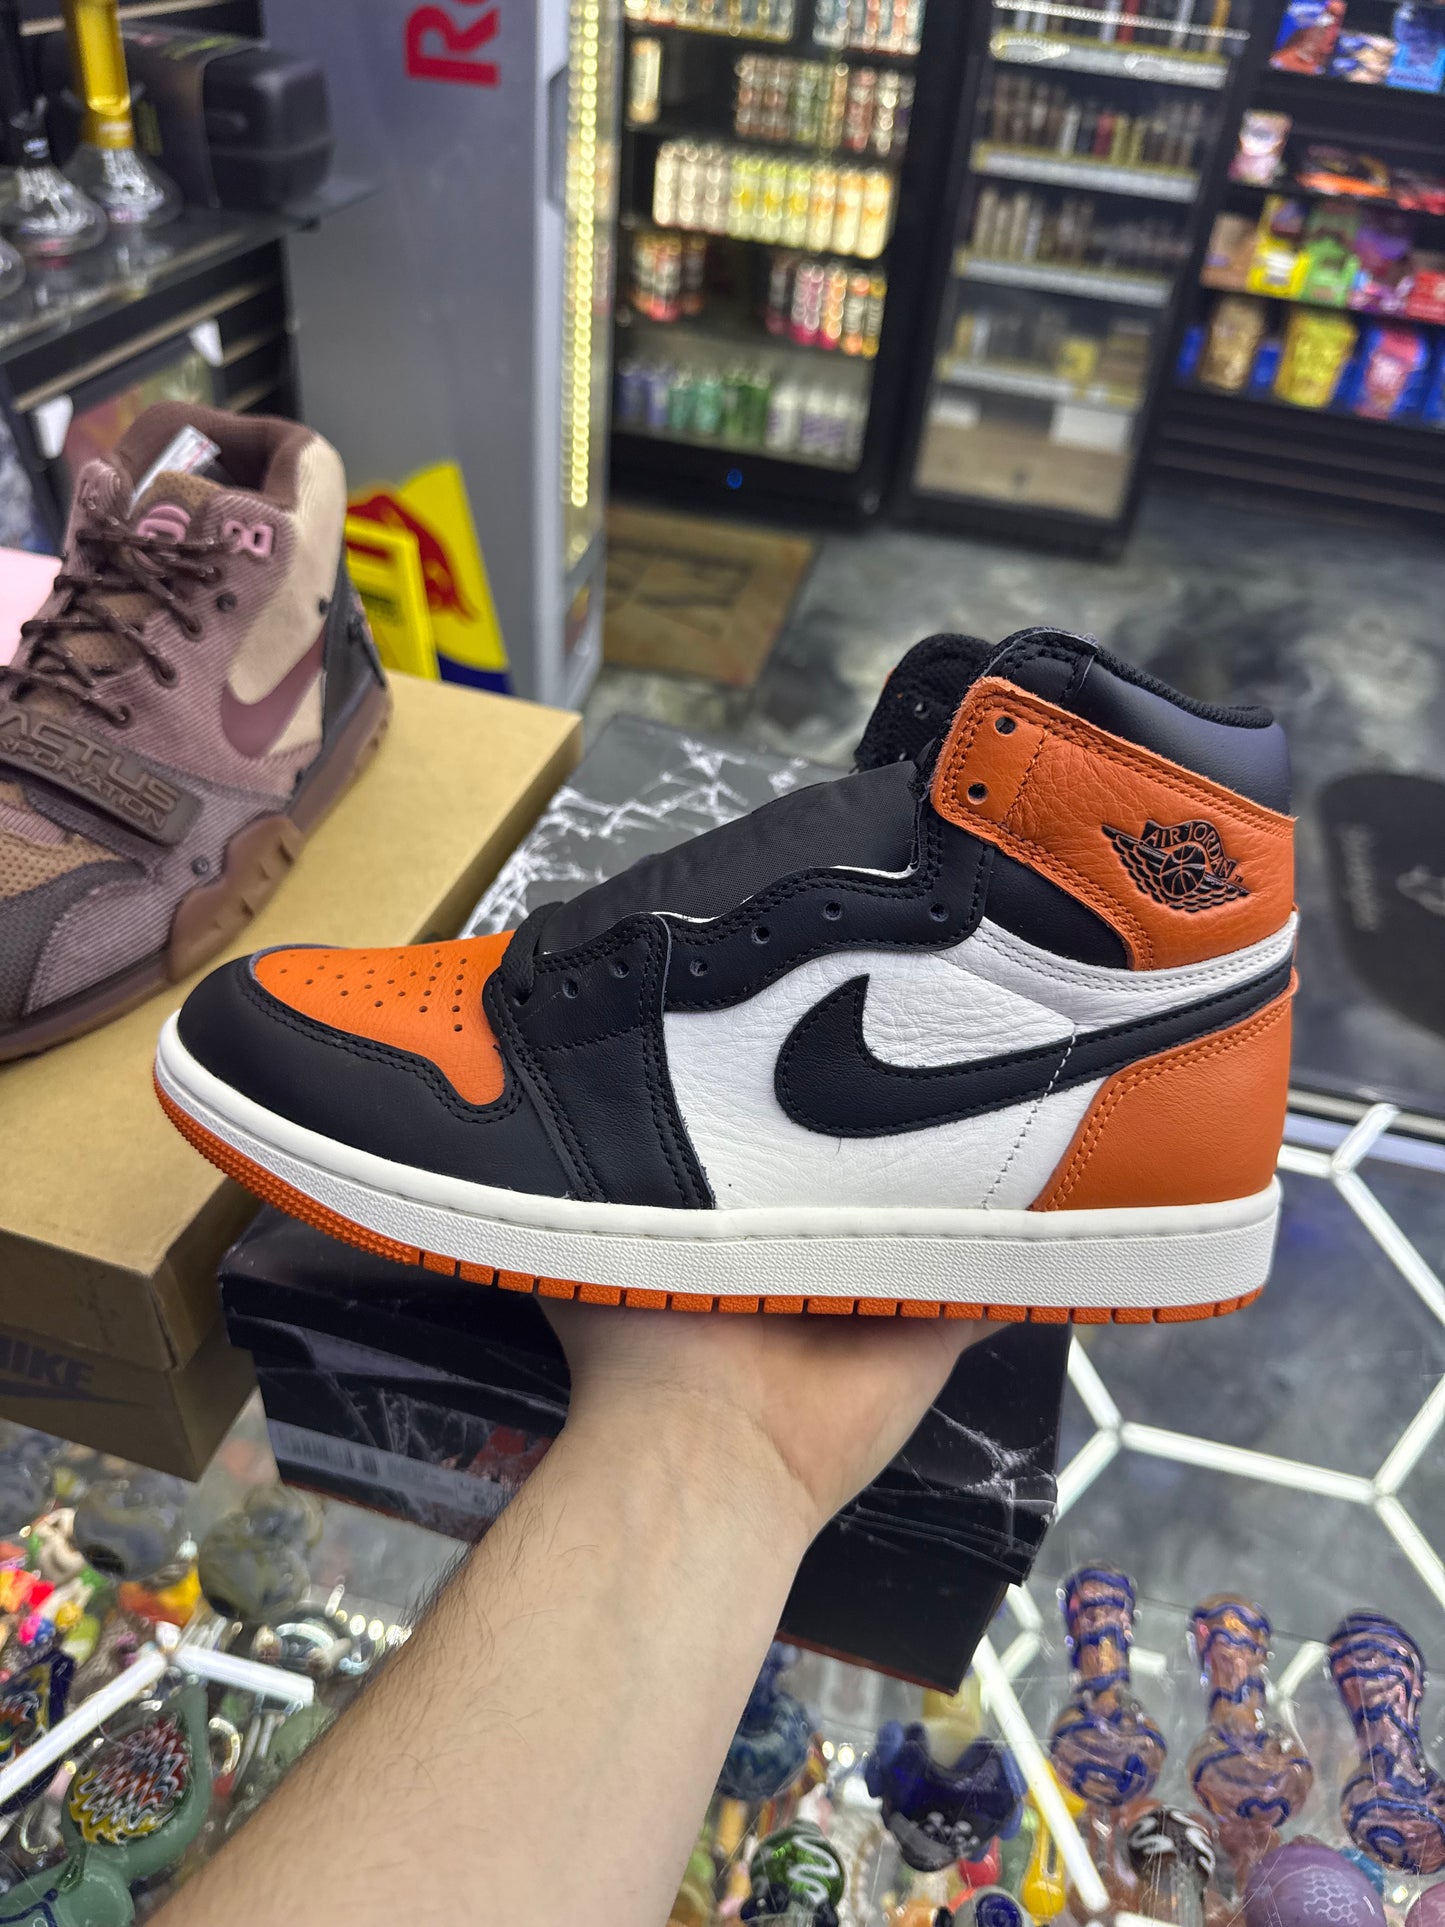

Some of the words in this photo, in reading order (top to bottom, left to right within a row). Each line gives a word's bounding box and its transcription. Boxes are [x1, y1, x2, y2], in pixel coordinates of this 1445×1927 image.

[403, 0, 501, 89] R
[1145, 827, 1182, 848] AIR
[1186, 821, 1234, 878] JORDAN
